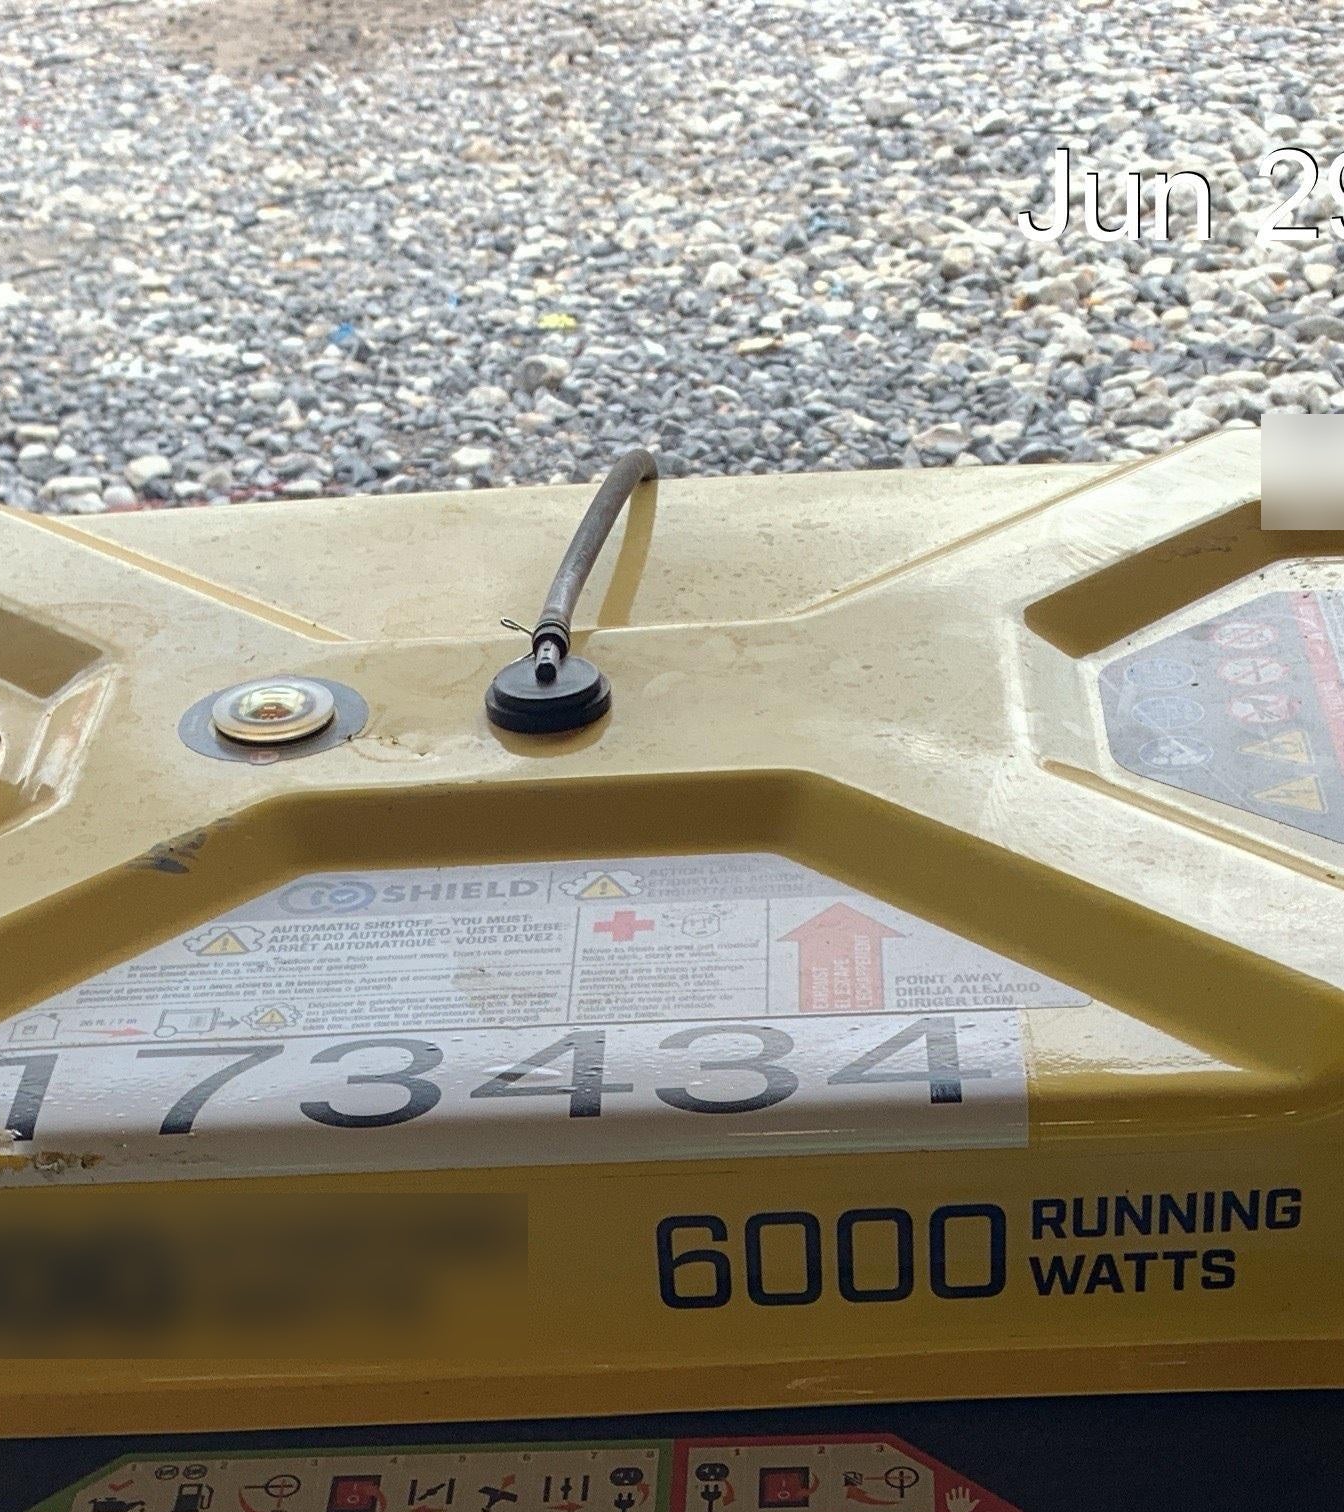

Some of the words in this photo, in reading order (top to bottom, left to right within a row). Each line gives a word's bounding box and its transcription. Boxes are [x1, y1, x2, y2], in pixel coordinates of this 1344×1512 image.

[382, 880, 540, 903] SHIELD
[268, 932, 344, 944] APAGADO
[466, 924, 517, 935] USTED
[270, 921, 359, 934] AUTOMATIC
[364, 918, 433, 930] SHUTOFF
[451, 916, 482, 926] YOU
[323, 936, 436, 951] AUTOMATIQUE
[456, 934, 498, 945] VOUS
[895, 974, 945, 986] POINT
[953, 972, 1002, 984] AWAY
[895, 985, 952, 998] DIRIJA
[959, 982, 1041, 995] ALEJADO
[896, 996, 967, 1009] DIRIGER
[973, 995, 1014, 1006] LOIN
[656, 1203, 1007, 1310] 6000
[1030, 1187, 1303, 1240] RUNNING
[1028, 1248, 1236, 1297] WATTS
